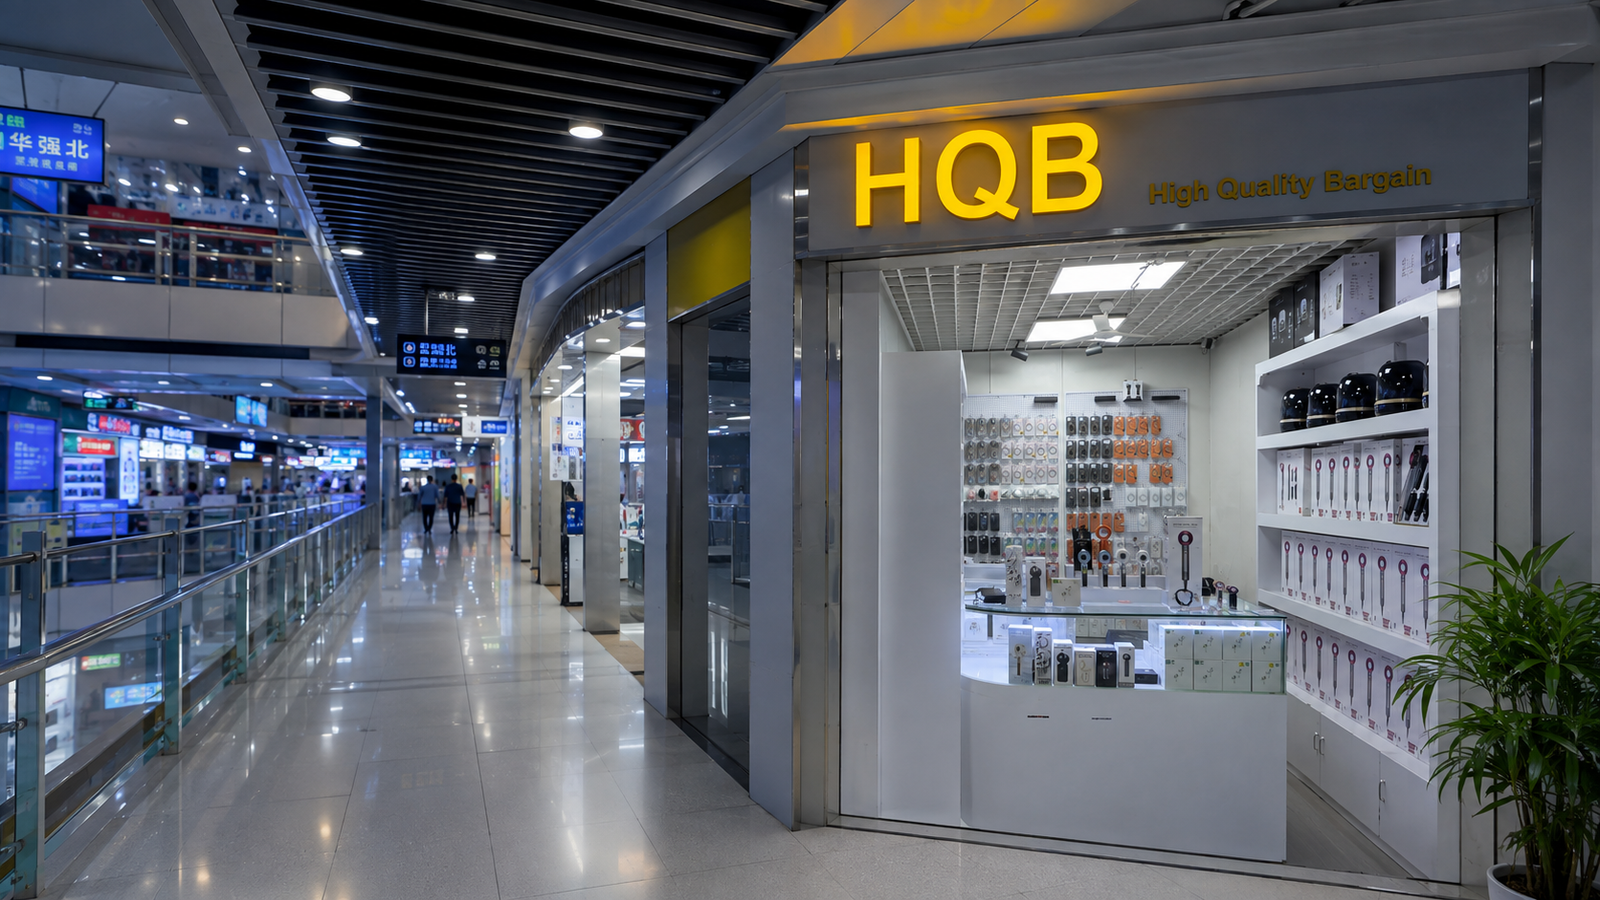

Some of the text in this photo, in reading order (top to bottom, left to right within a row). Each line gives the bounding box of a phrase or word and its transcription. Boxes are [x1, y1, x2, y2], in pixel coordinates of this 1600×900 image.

[9, 132, 89, 159] 华强北
[855, 122, 1103, 228] HQB
[1149, 164, 1432, 207] High Quality Bargain
